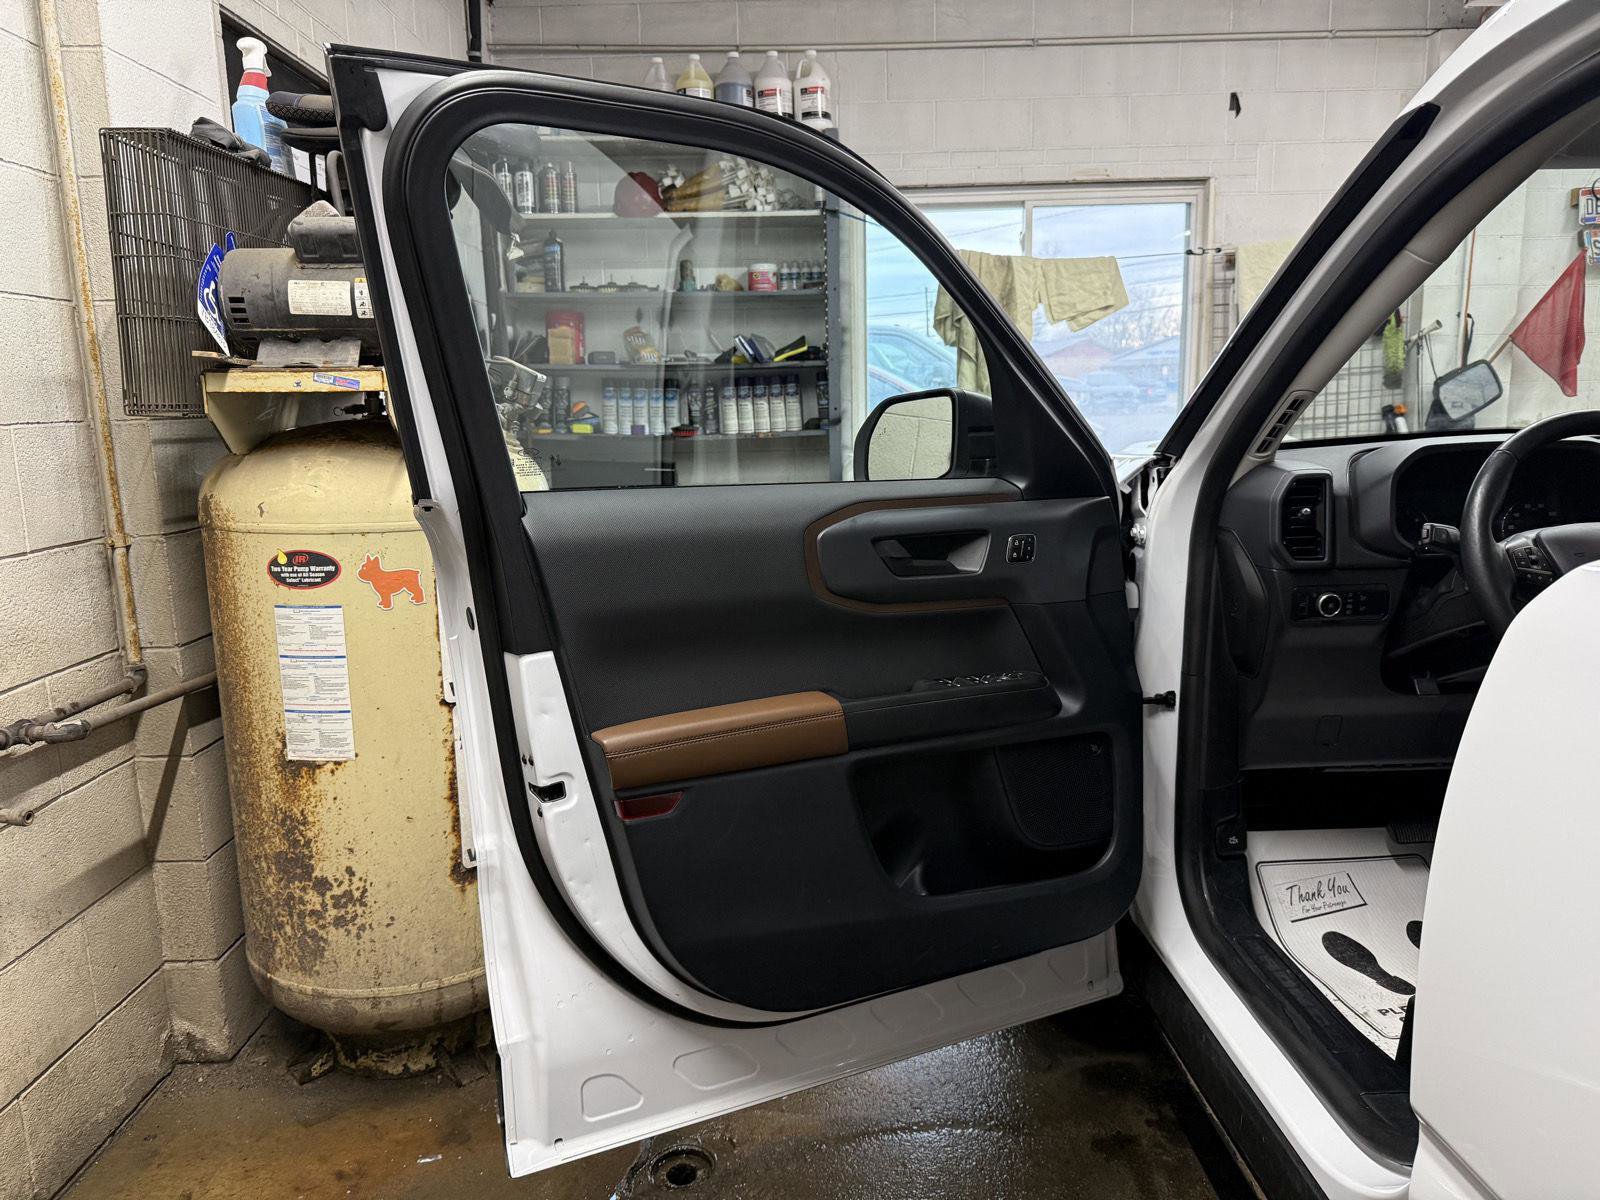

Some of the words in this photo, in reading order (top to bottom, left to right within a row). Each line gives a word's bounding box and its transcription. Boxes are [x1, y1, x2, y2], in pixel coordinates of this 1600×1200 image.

[293, 565, 309, 573] Pump
[1285, 880, 1326, 907] Thank
[1327, 876, 1351, 898] You
